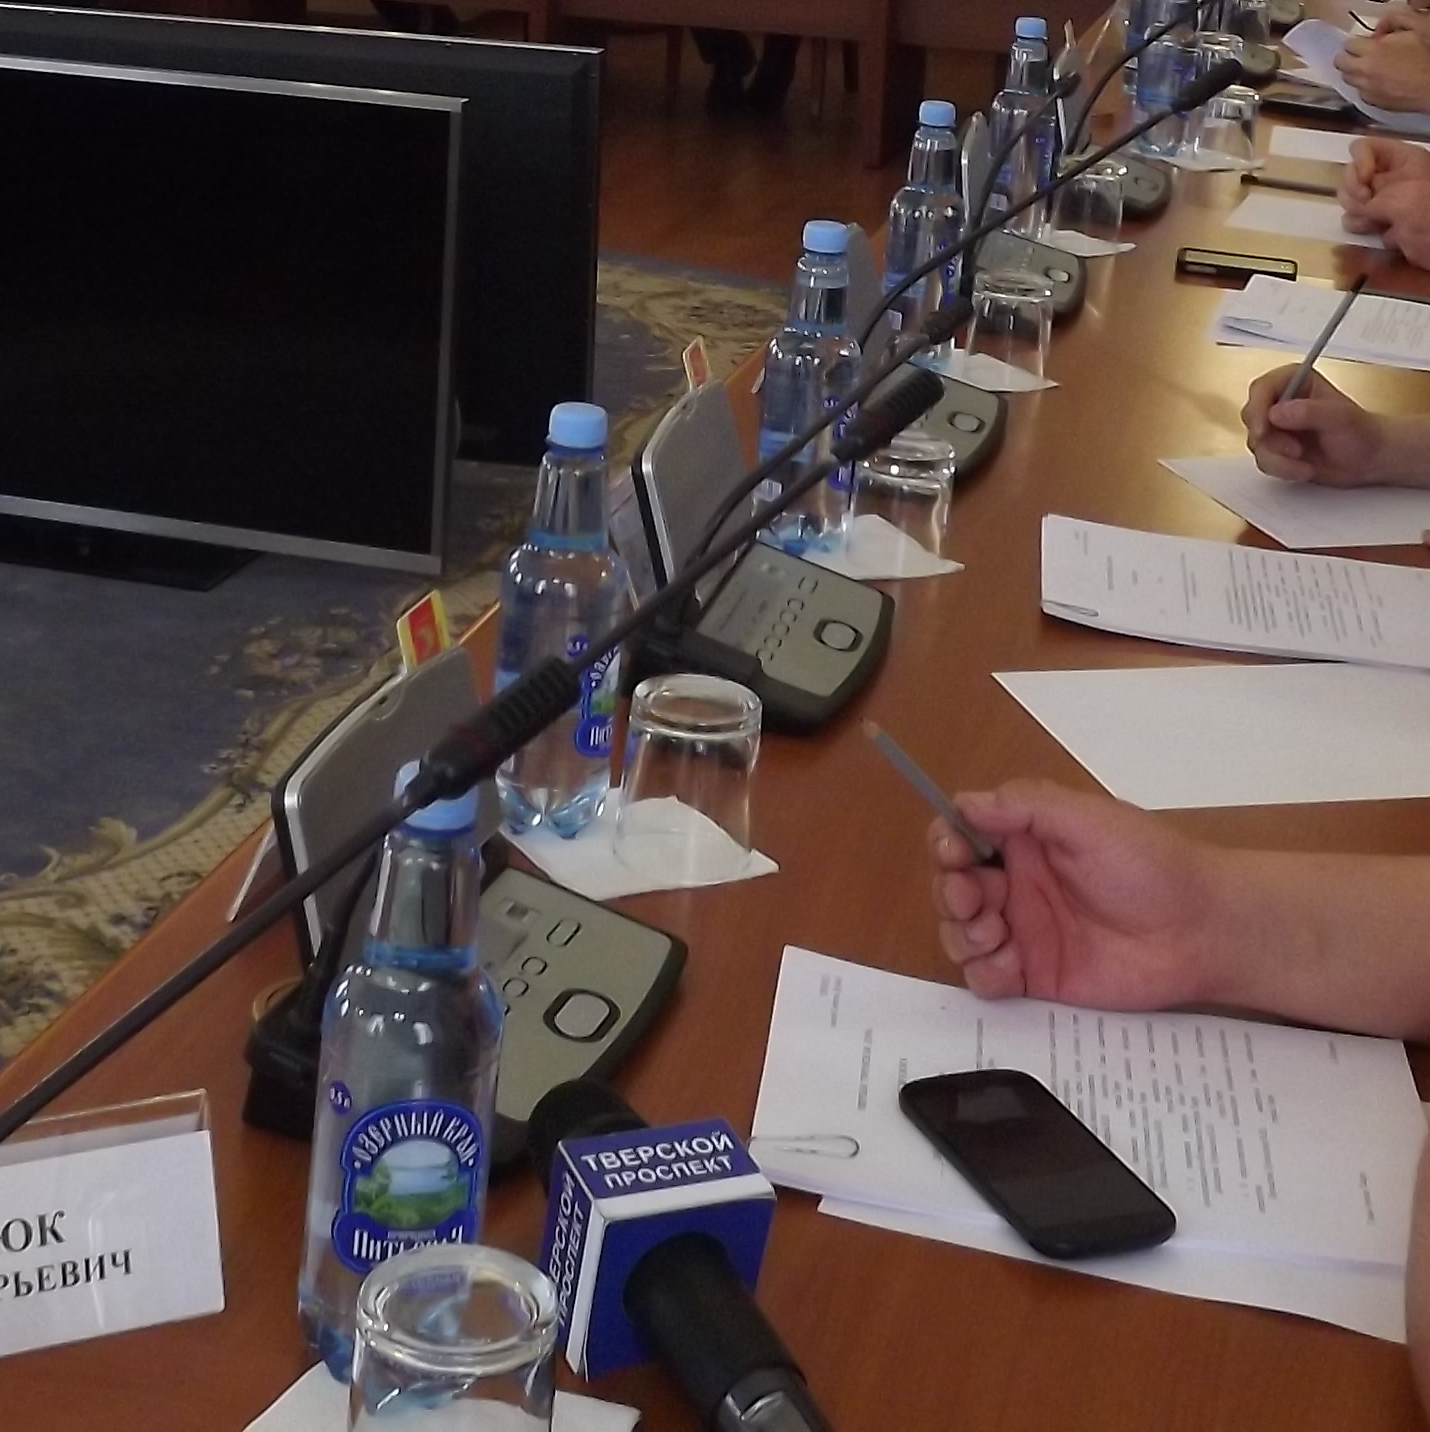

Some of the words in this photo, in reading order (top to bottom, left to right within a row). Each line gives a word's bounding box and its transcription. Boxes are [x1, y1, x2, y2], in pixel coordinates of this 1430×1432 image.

[352, 1109, 444, 1162] ОЗЕРНЫЙ
[579, 1130, 735, 1172] ТВЕРСКОЙ
[603, 1154, 733, 1190] ПРОСПЕКТ
[548, 1169, 577, 1285] ЕРСКОЙ
